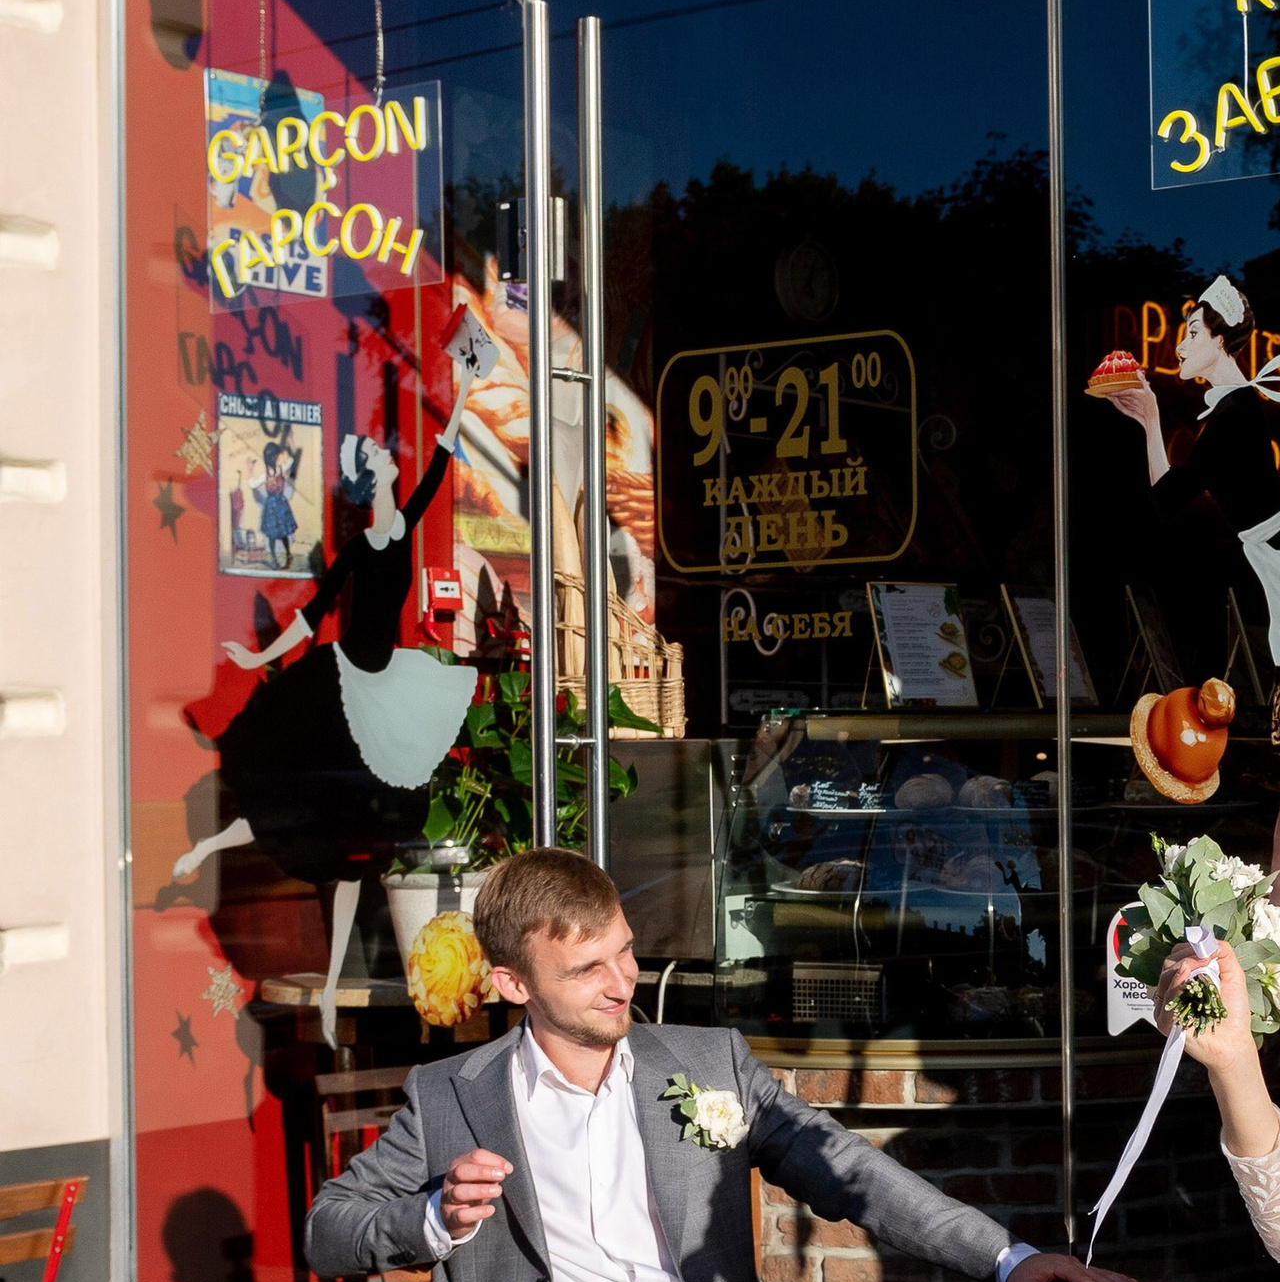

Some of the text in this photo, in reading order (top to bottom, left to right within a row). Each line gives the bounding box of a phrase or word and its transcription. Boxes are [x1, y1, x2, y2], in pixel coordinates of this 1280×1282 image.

[210, 200, 424, 299] ГАРСОН
[279, 401, 322, 424] MENIER
[703, 457, 868, 507] КАЖДЫЙ
[721, 509, 849, 560] ДЕНЬ
[771, 611, 853, 640] СЕБЯ
[1113, 978, 1148, 991] Хоро
